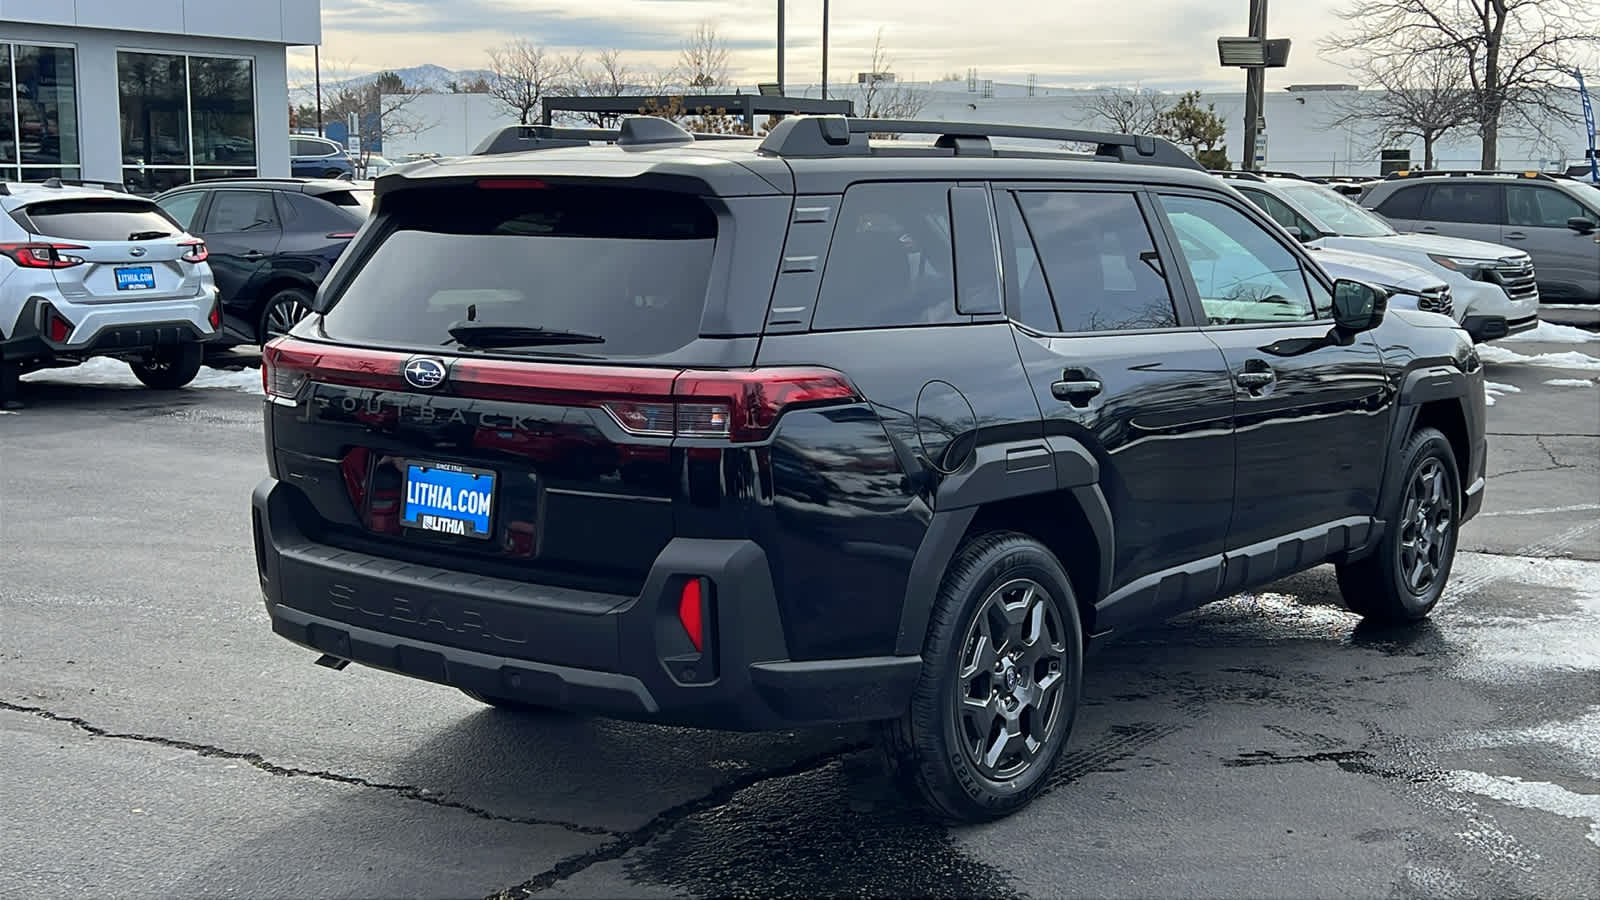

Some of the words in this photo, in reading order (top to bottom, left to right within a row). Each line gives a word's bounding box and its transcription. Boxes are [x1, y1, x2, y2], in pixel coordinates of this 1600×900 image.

[341, 396, 529, 430] OUTBACK
[407, 481, 491, 517] LITHIA.COM
[432, 516, 465, 535] LITHIA
